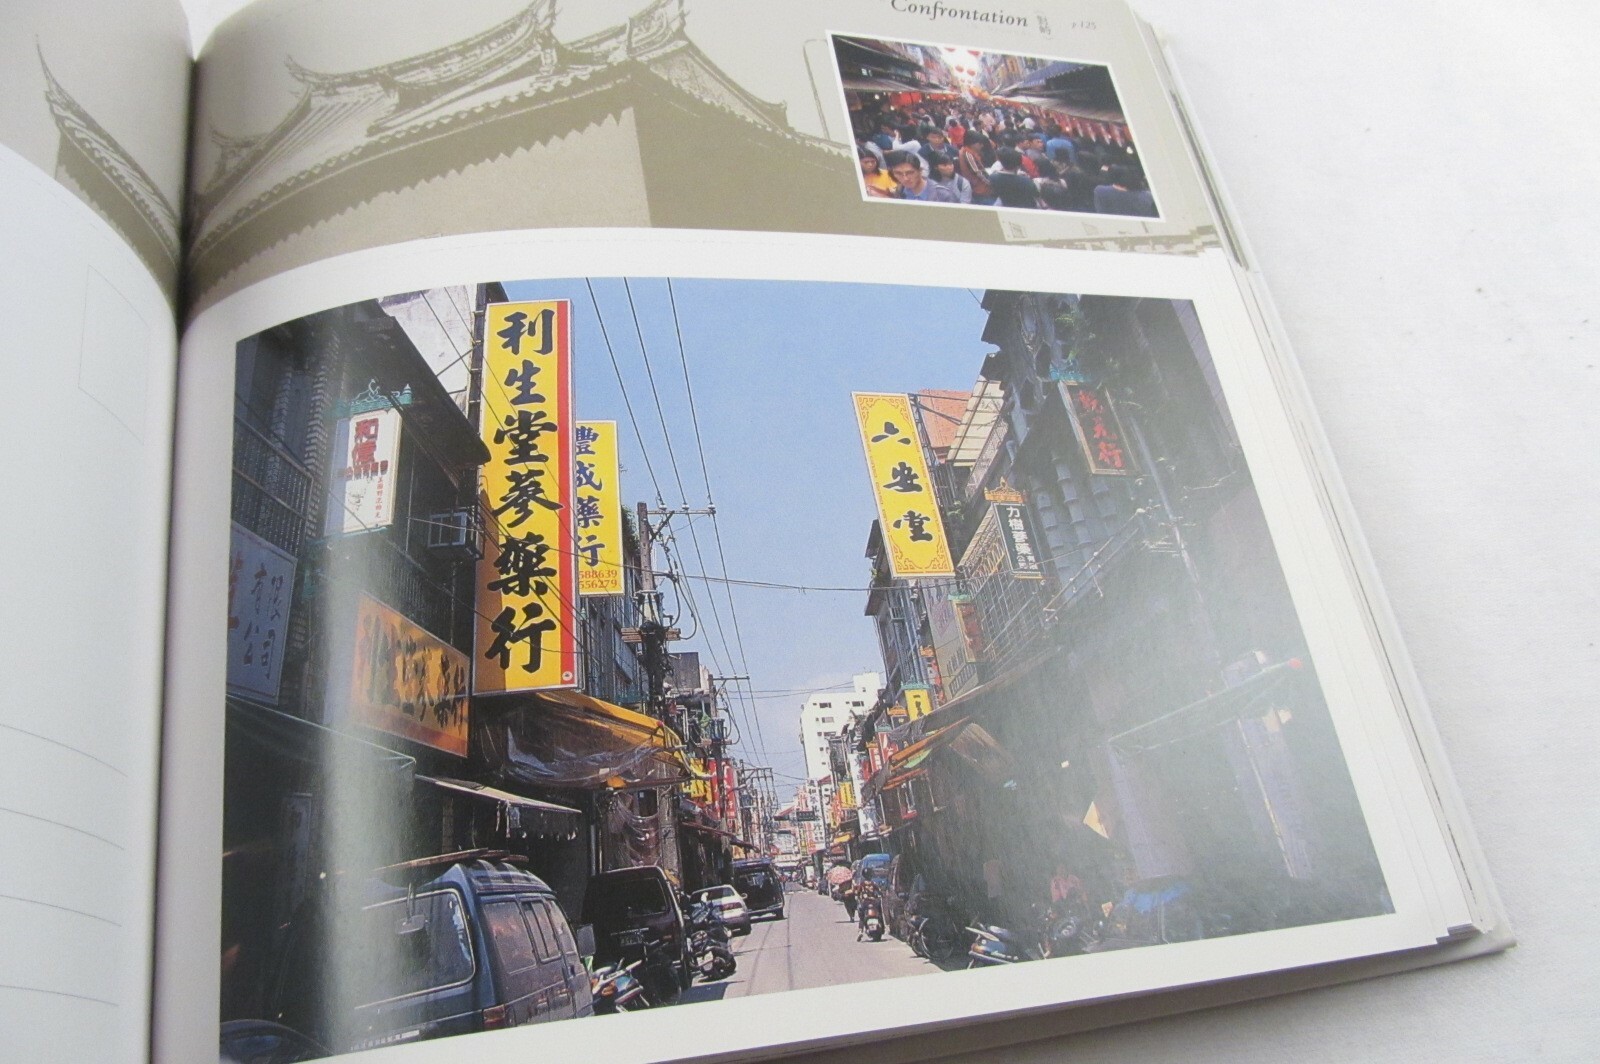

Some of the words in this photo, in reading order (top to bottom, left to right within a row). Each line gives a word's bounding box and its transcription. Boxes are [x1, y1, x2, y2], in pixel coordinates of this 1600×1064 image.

[891, 0, 1029, 28] Confrontation
[871, 421, 933, 542] 六安堂
